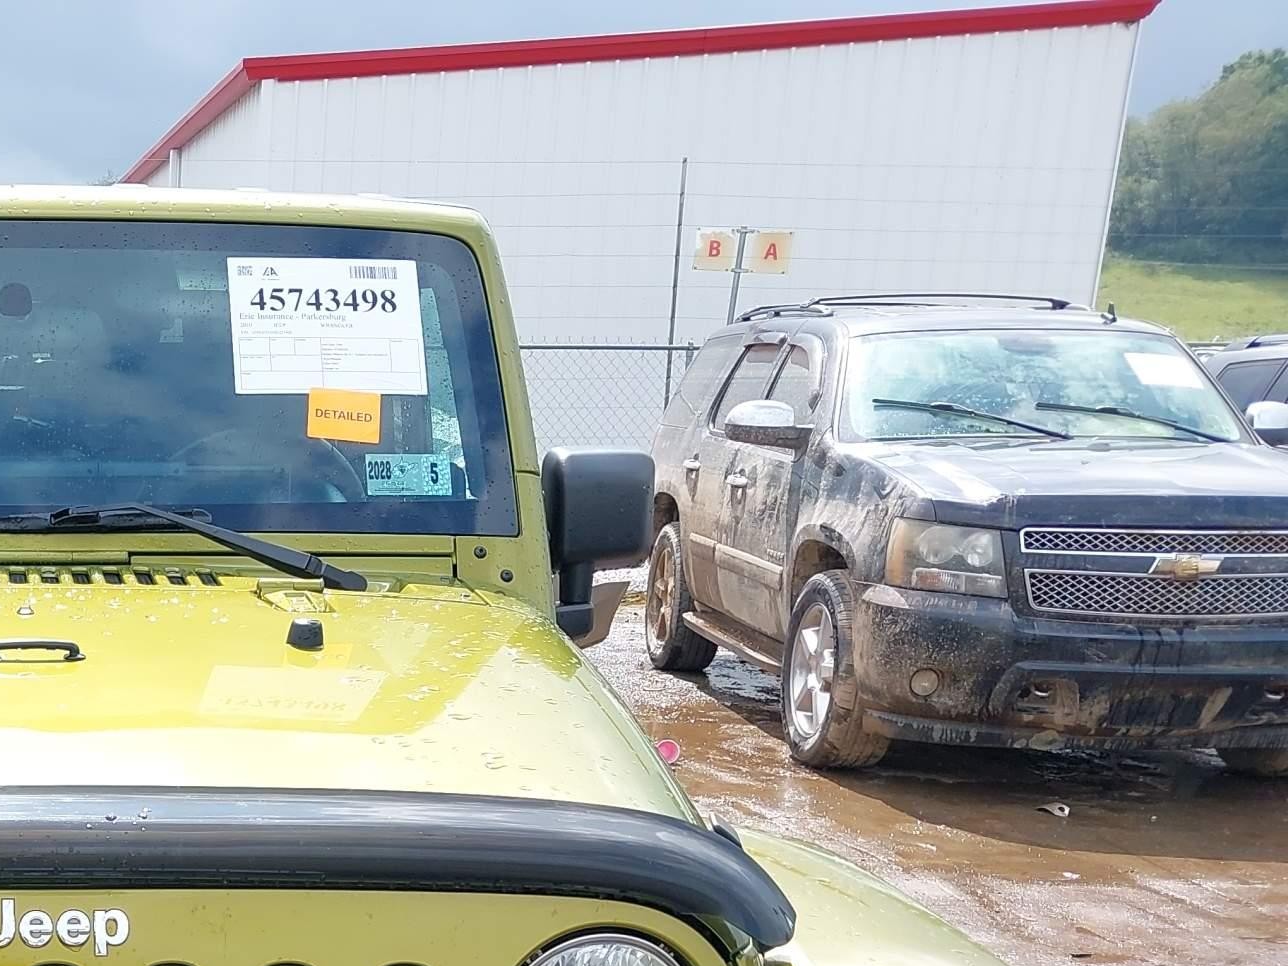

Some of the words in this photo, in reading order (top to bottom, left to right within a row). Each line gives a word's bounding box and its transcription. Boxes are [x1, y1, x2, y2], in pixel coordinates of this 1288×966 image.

[708, 240, 721, 257] B
[764, 243, 778, 260] A
[250, 287, 398, 313] 45743498
[315, 408, 373, 423] DETAILED
[367, 460, 392, 480] 2028
[430, 462, 439, 484] 5
